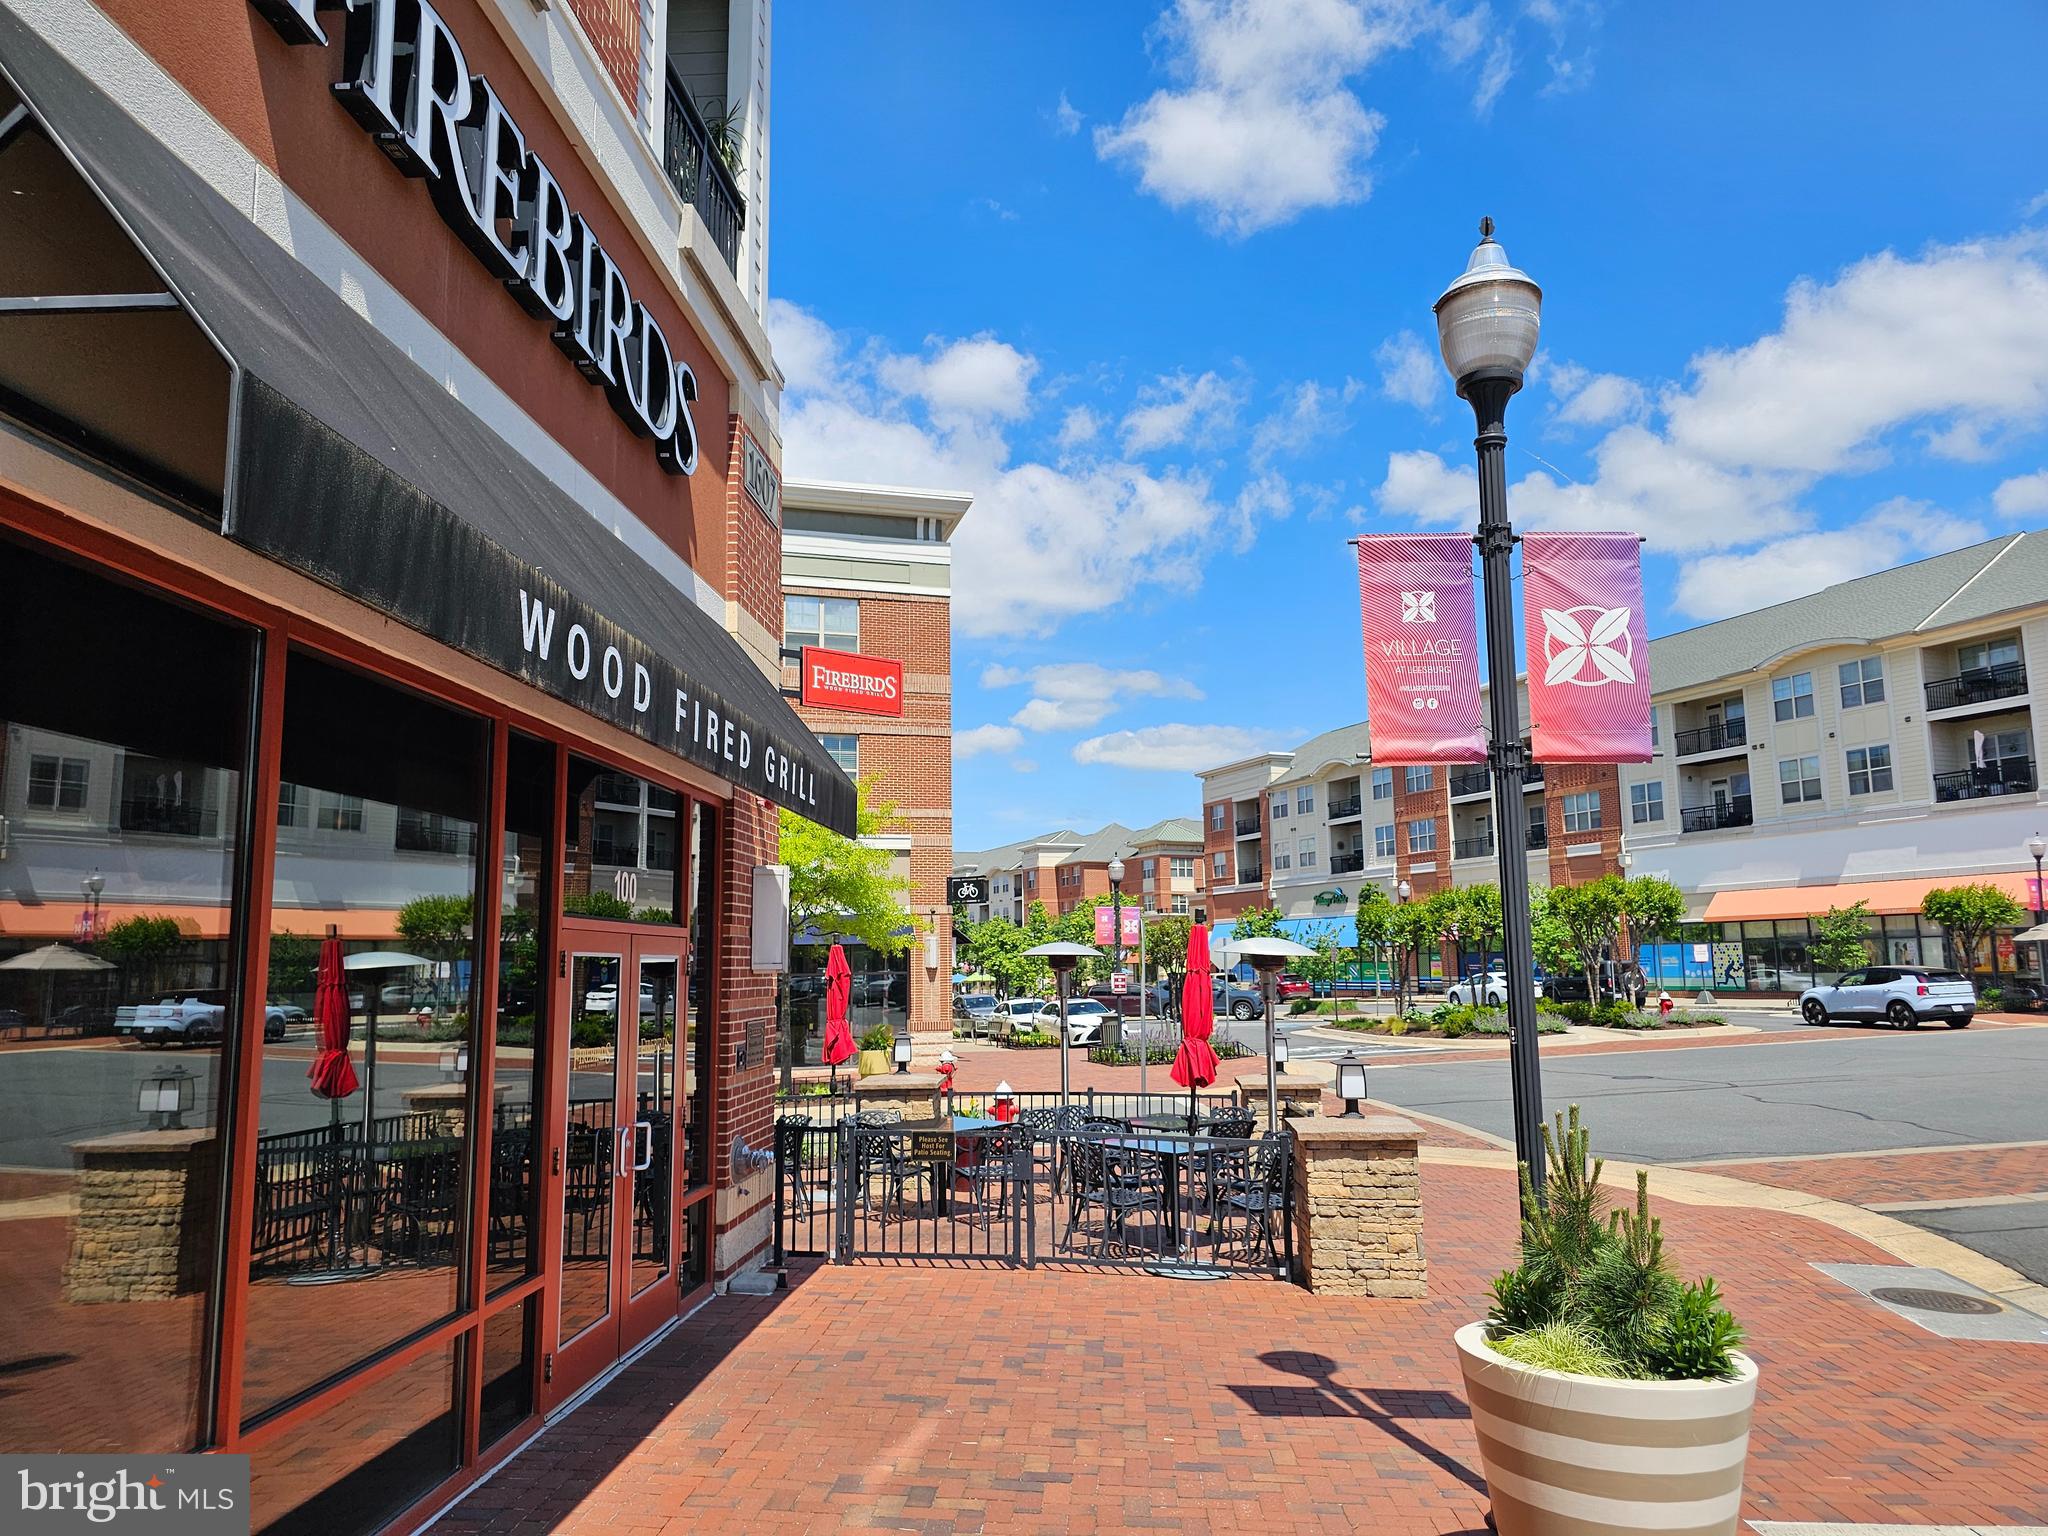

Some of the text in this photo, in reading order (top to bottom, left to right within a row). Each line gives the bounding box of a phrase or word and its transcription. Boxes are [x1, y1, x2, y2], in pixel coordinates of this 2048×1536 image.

[262, 0, 699, 476] IREBIRDS
[748, 450, 777, 513] 1607
[1380, 639, 1463, 657] VILLAGE
[811, 665, 898, 699] FIREBIRDS
[1395, 665, 1452, 674] AT LEESBURG
[519, 588, 816, 806] WOOD FIRED GRILL
[614, 869, 637, 904] 100
